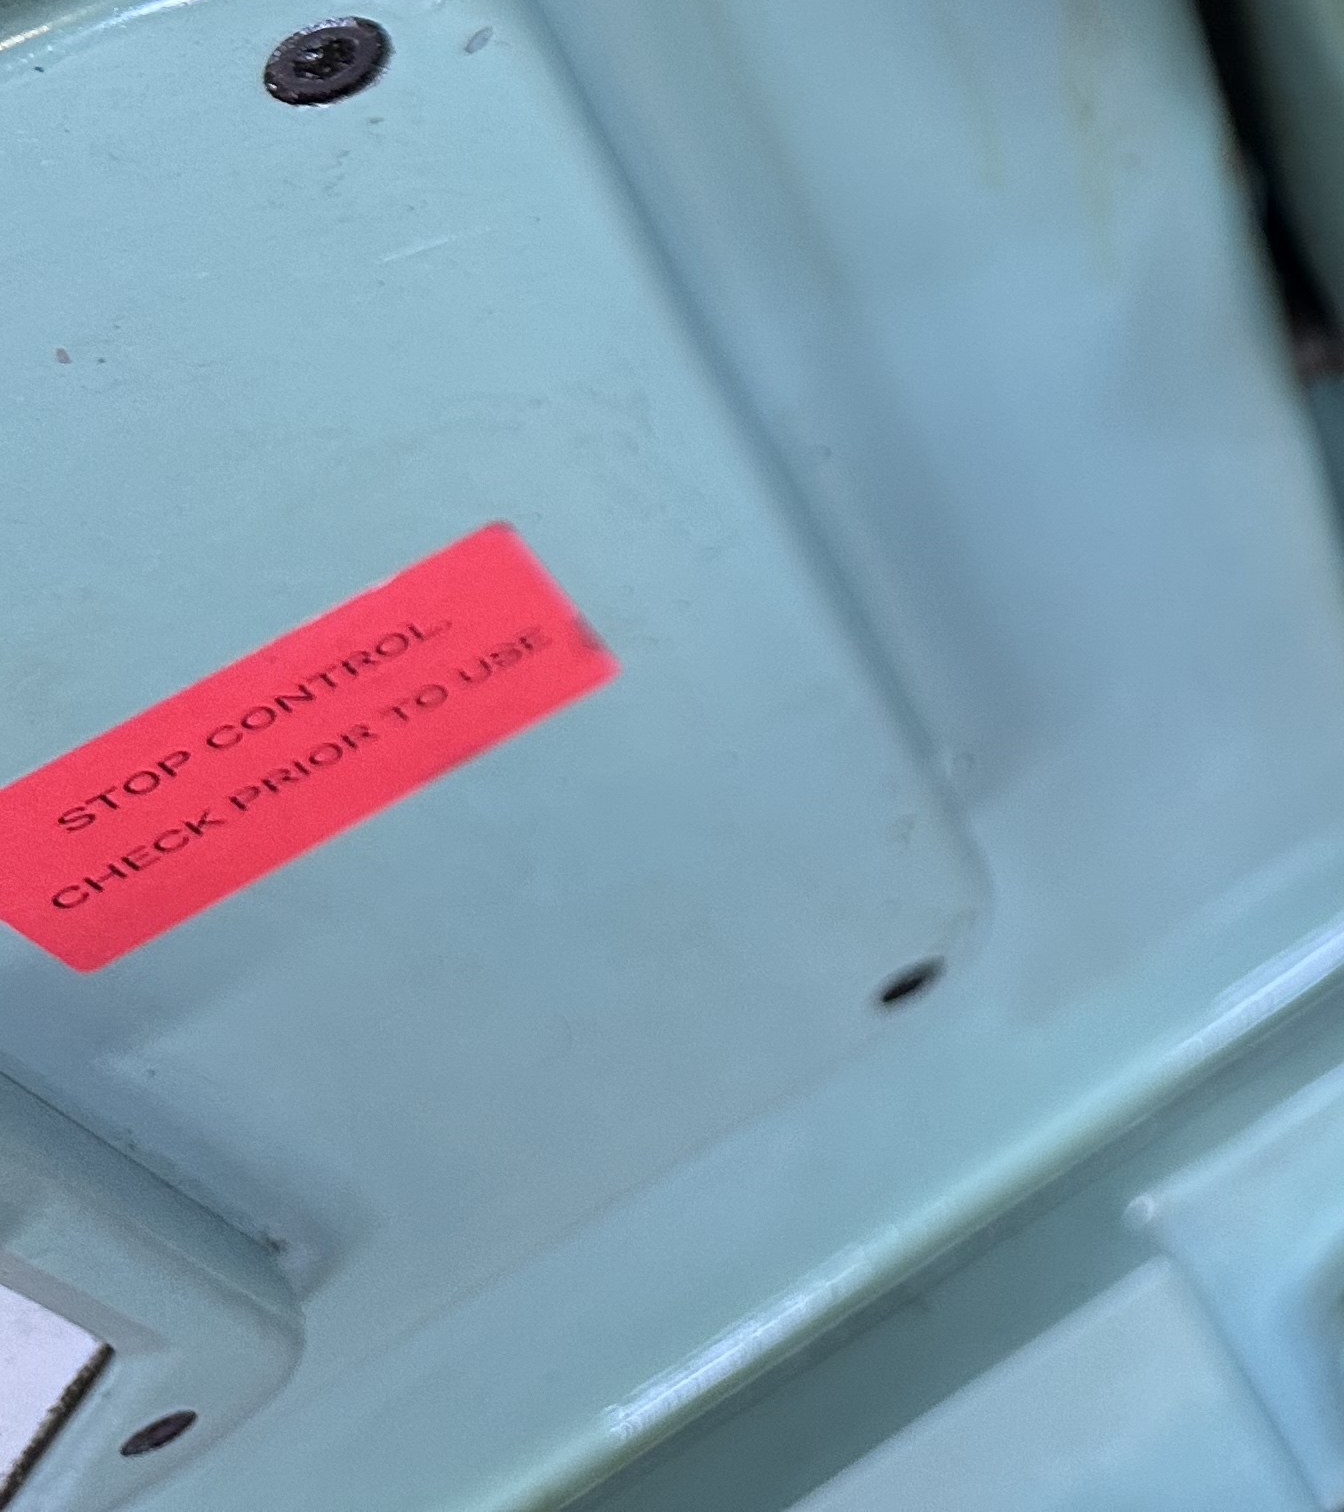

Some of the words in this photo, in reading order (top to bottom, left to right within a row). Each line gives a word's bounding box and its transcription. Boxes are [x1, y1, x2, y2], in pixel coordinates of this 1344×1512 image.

[51, 810, 226, 911] CHECK
[228, 723, 380, 813] PRIOR
[383, 683, 450, 724] TO
[457, 626, 554, 687] USE
[57, 748, 192, 833] STOP
[206, 619, 452, 751] CONTROL
